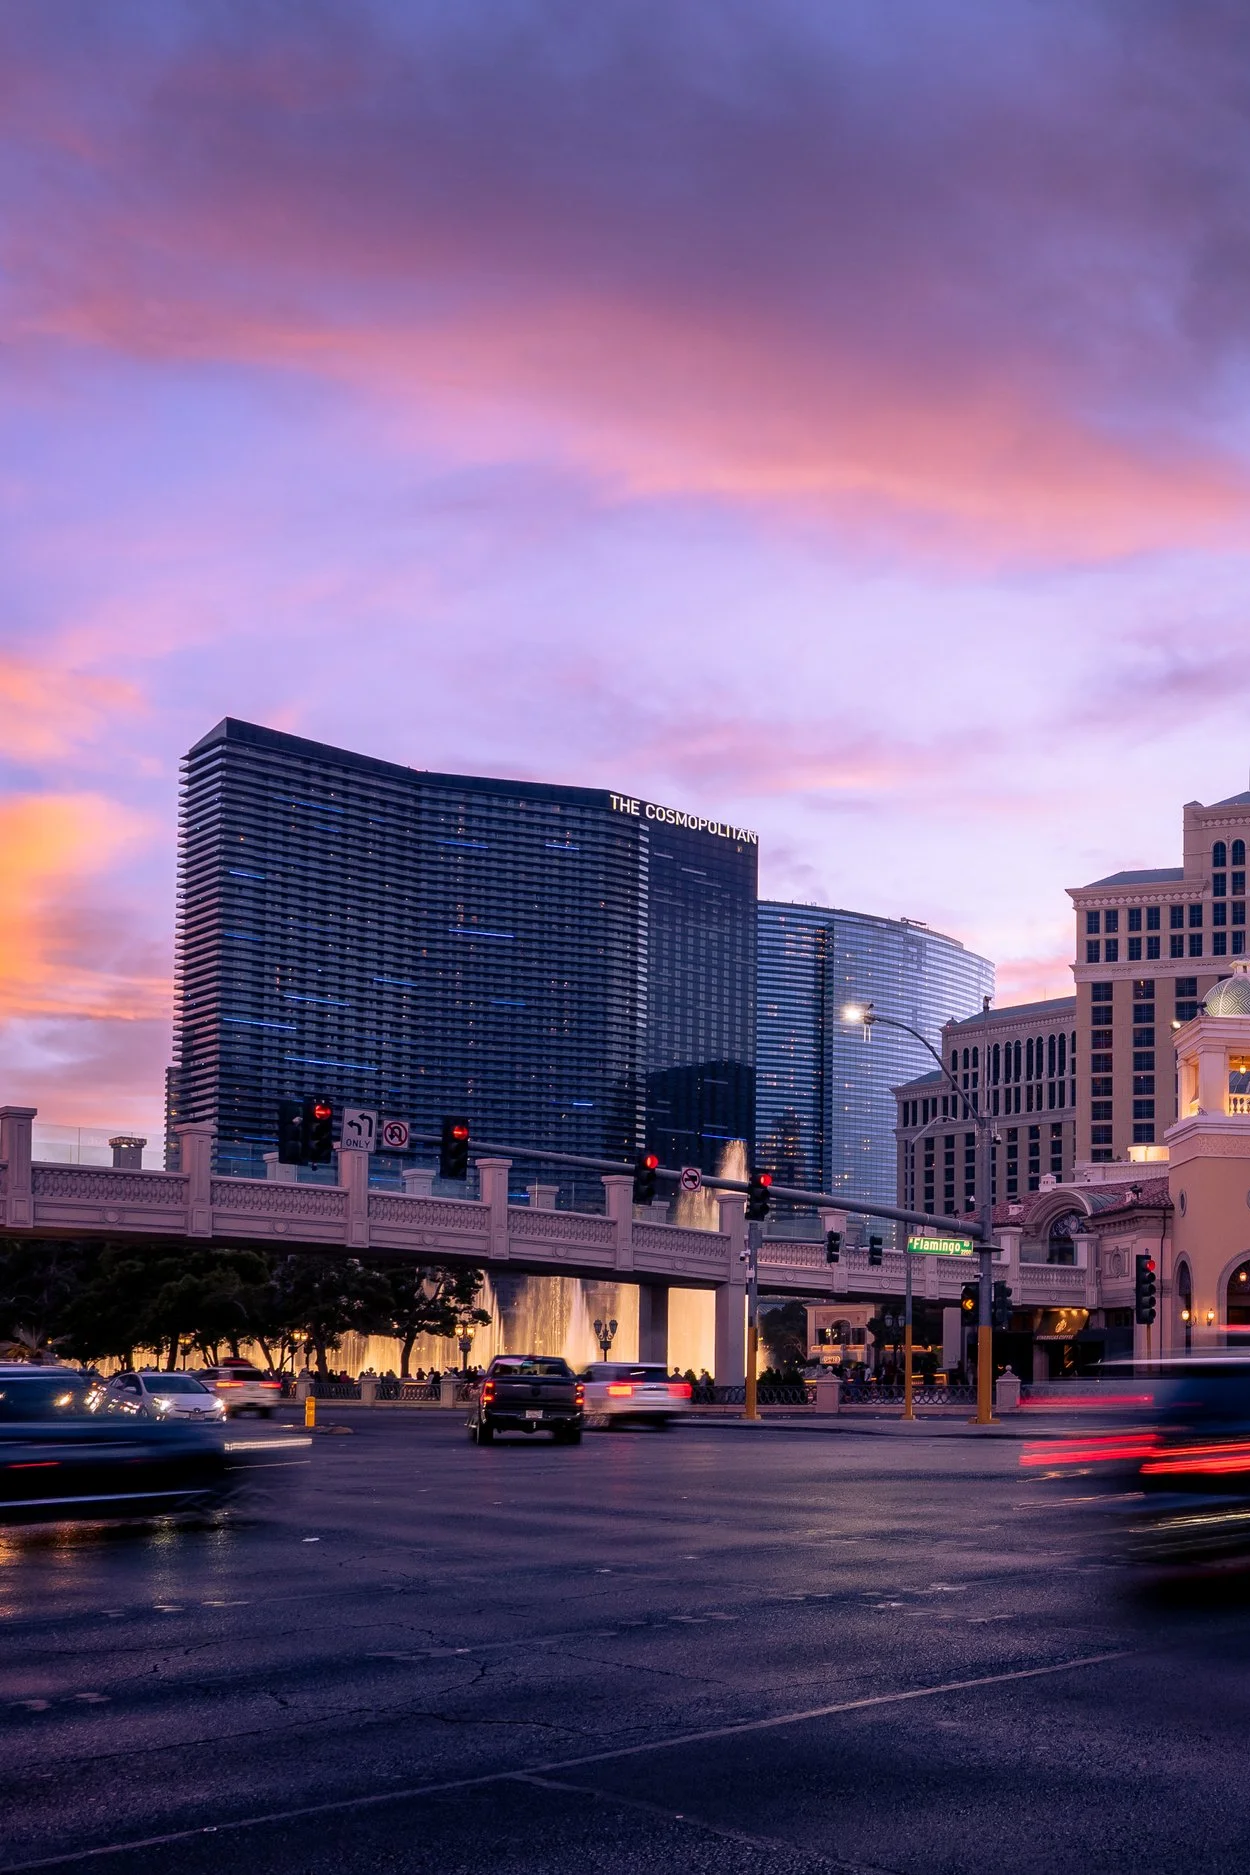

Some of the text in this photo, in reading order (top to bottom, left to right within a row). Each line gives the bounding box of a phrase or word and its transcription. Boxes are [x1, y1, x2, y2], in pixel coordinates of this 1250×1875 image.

[609, 794, 758, 845] THE COSMOPOLITAN
[345, 1138, 371, 1149] ONLY
[912, 1237, 960, 1256] Flamingo
